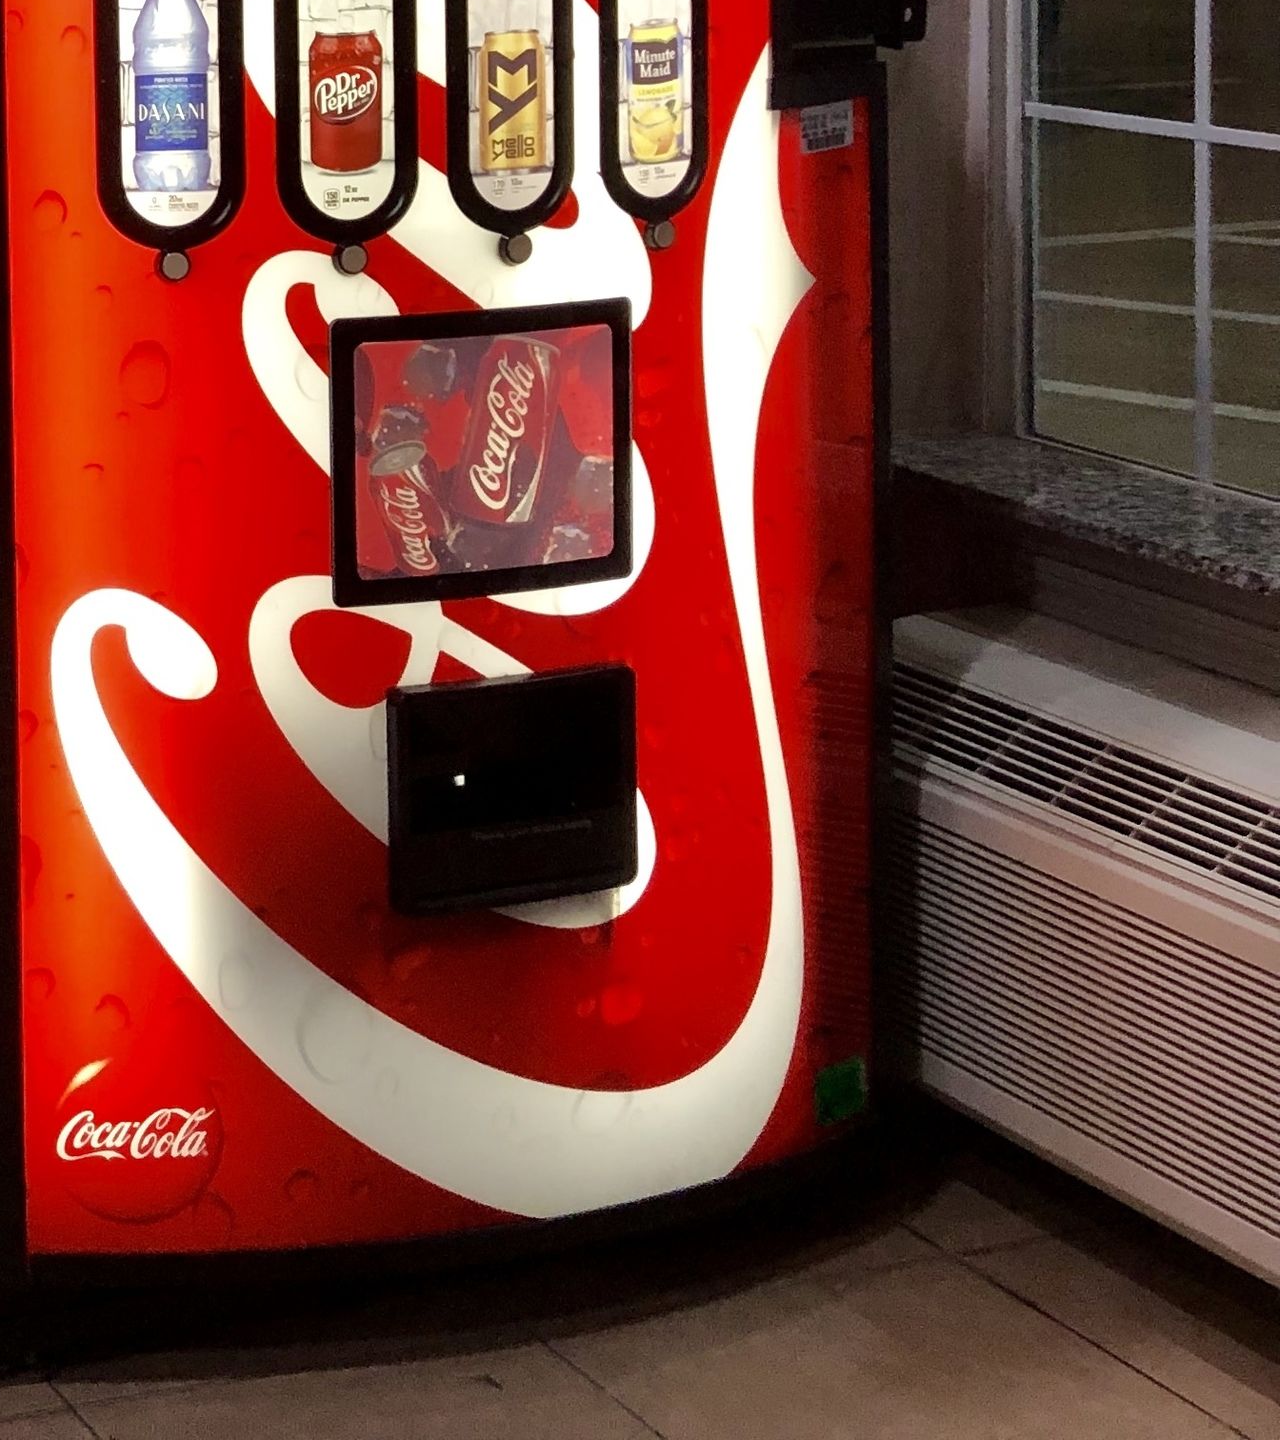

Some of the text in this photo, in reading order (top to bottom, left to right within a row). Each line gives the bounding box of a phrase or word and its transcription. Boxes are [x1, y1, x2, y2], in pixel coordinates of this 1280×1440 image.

[633, 47, 677, 66] Minute
[639, 62, 672, 80] Maid
[334, 72, 361, 95] Dr
[319, 79, 376, 115] Pepper
[138, 101, 206, 123] DASANI
[468, 350, 537, 511] Coca-Cola
[55, 1105, 215, 1161] Coca-Cola
